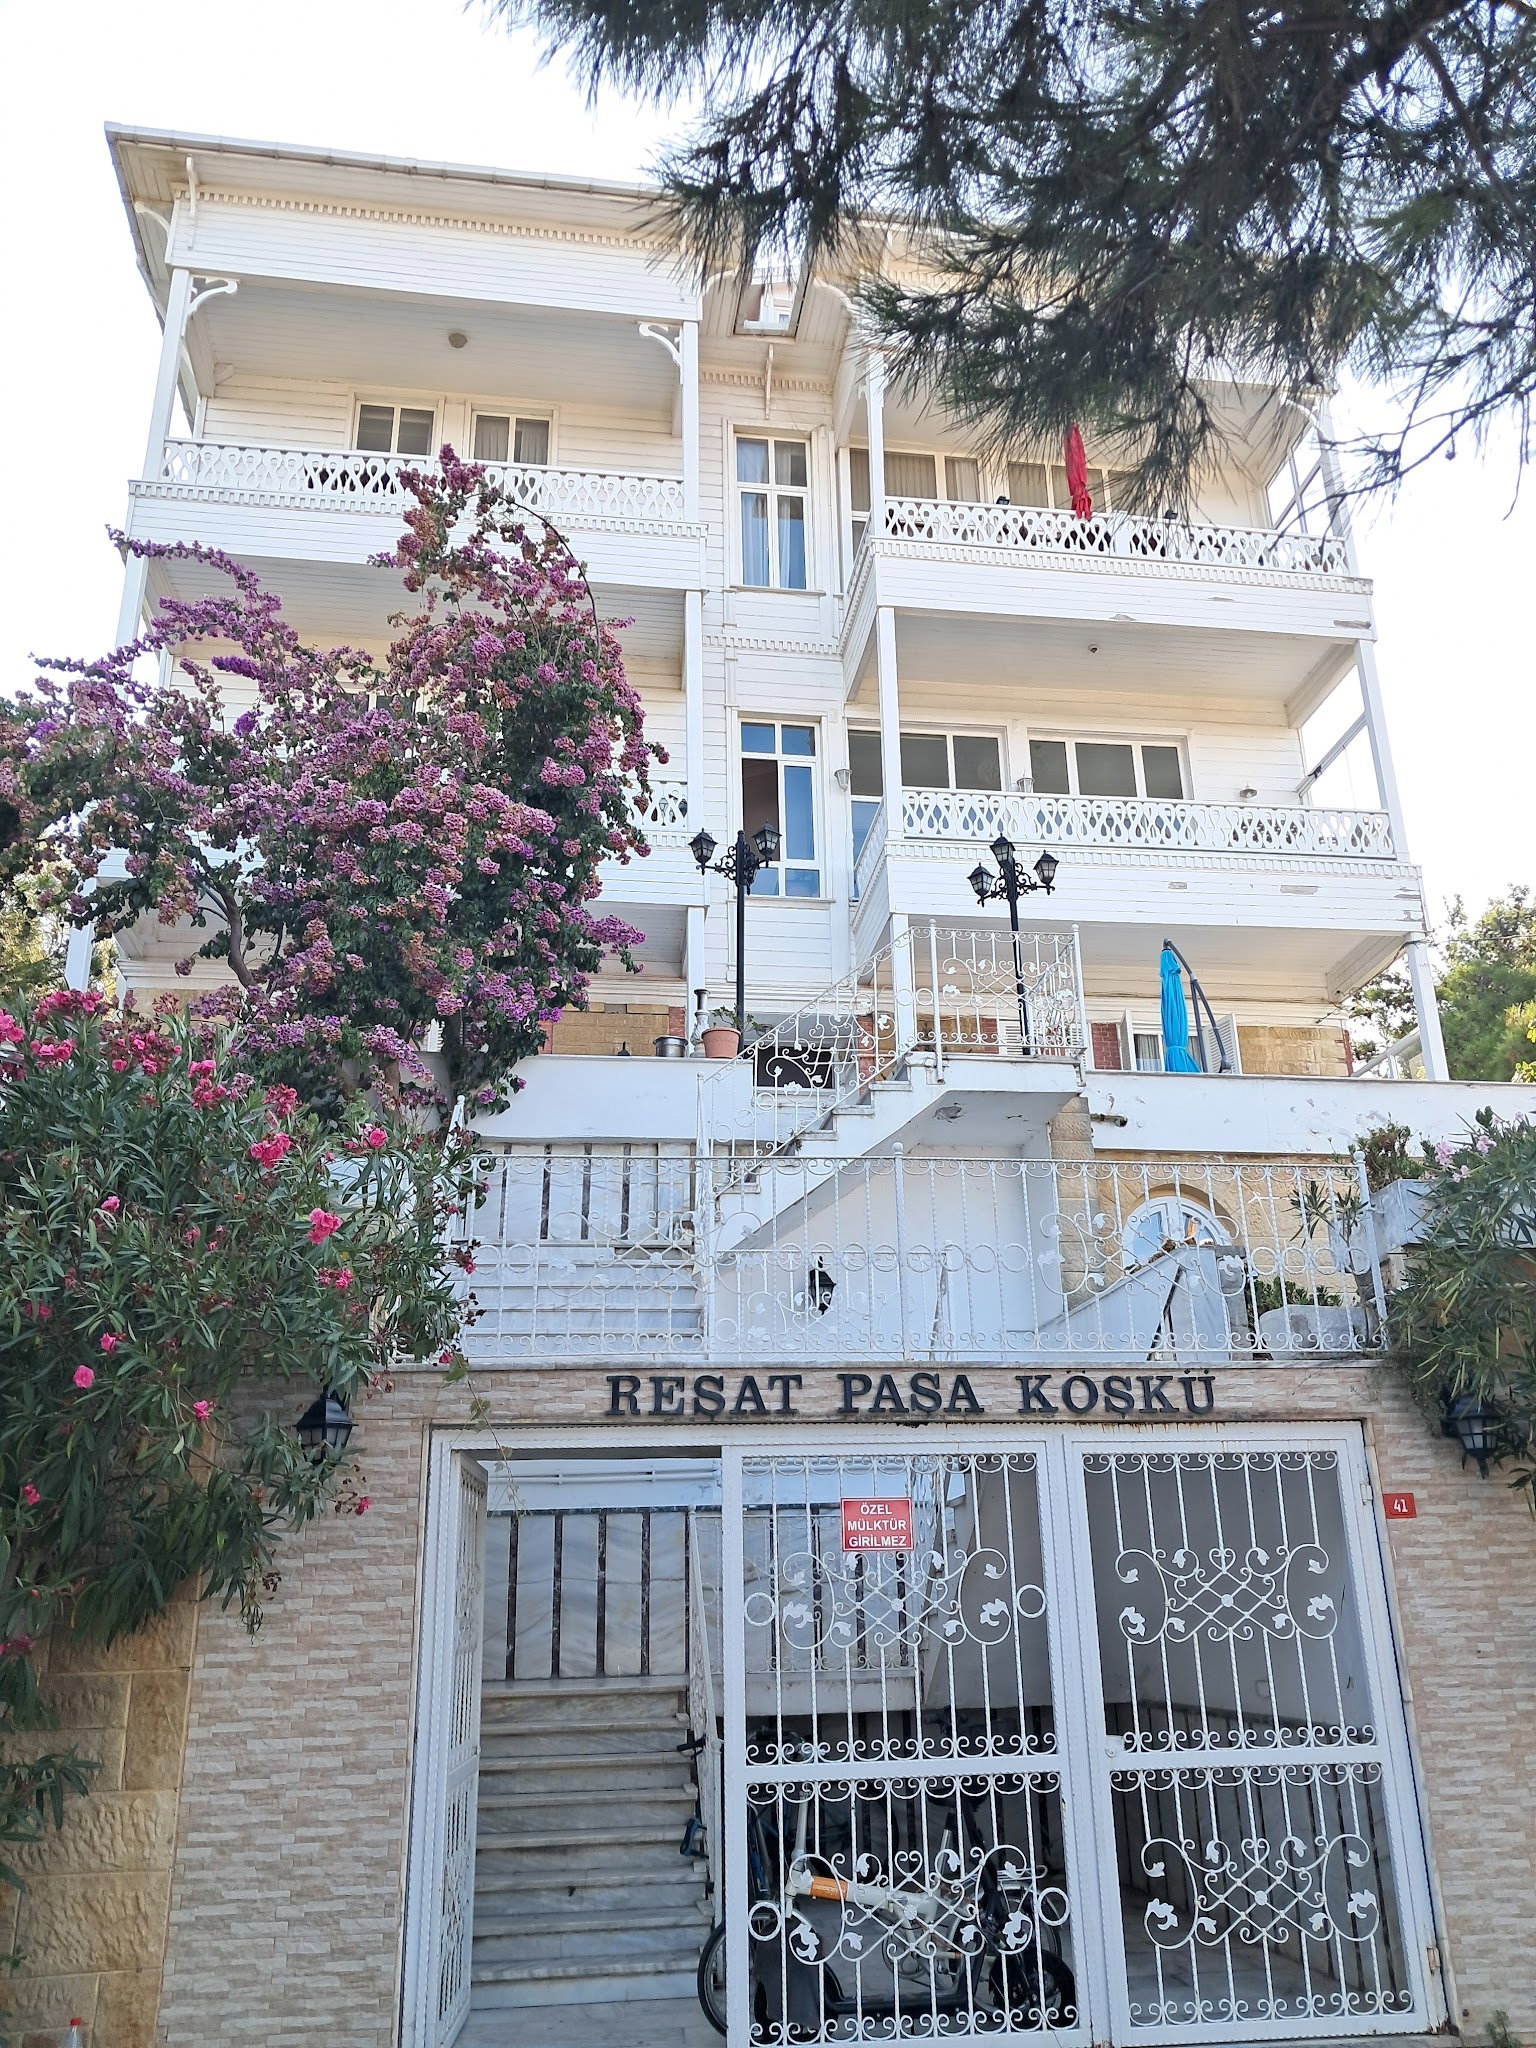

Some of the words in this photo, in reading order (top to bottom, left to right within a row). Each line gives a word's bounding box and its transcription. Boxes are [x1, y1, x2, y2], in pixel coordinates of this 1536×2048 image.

[605, 1374, 803, 1421] REŞAT
[837, 1372, 985, 1416] PAŞA
[1015, 1369, 1216, 1419] KÖŞKÜ
[860, 1502, 893, 1515] ÖZEL
[1393, 1499, 1409, 1513] 41
[847, 1518, 907, 1531] MÜLKTÜR
[848, 1534, 907, 1547] GİRİLMEZ
